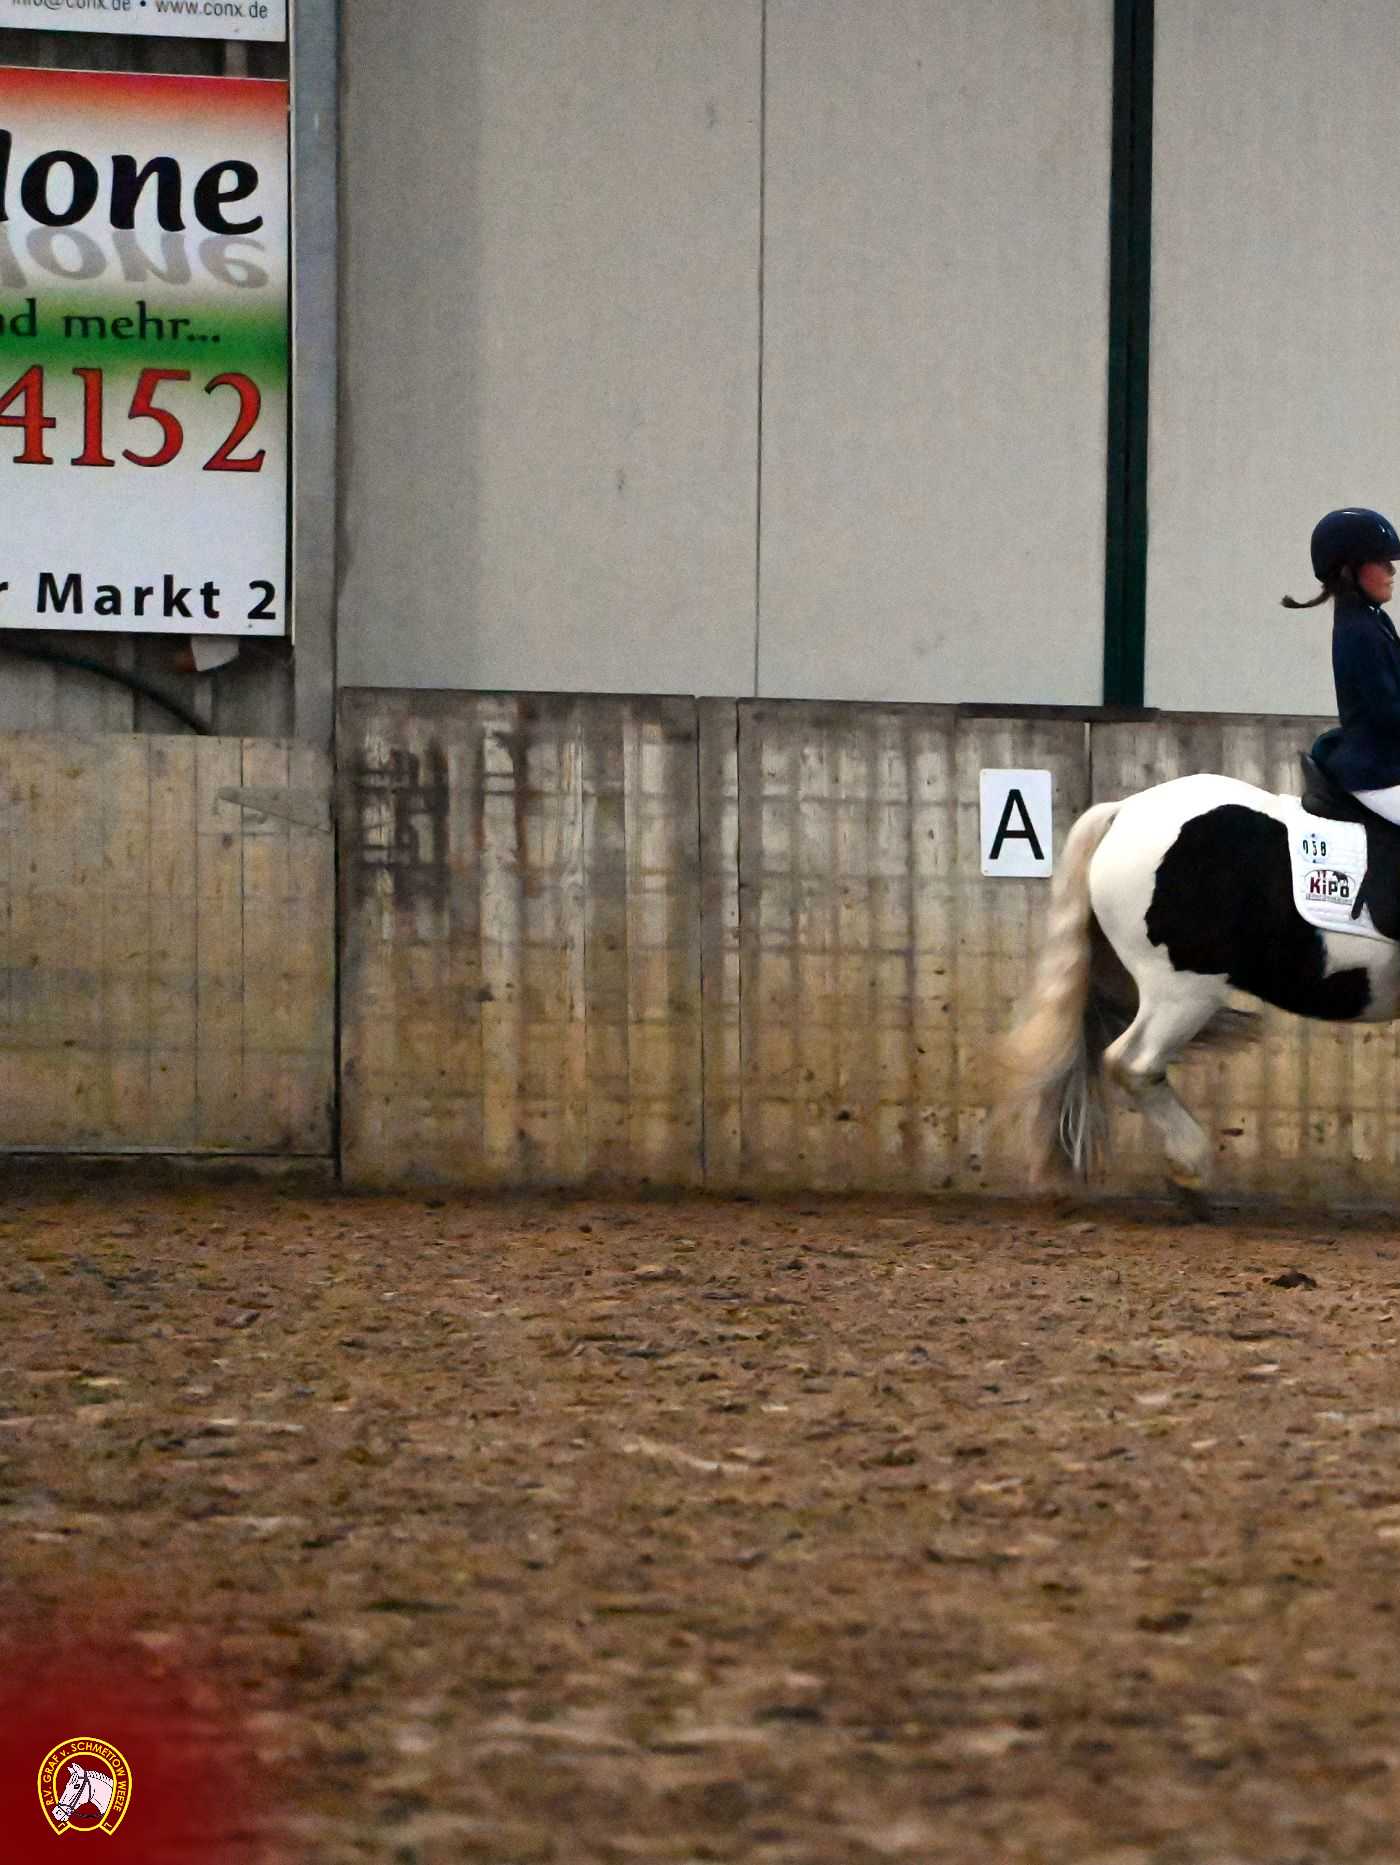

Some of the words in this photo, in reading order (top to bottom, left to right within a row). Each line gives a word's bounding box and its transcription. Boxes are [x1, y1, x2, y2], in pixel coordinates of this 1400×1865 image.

[155, 0, 268, 18] www.conx.de
[0, 297, 37, 338] d
[64, 301, 220, 343] mehr...
[0, 364, 266, 473] 4152
[36, 571, 220, 619] Markt
[247, 580, 277, 620] 2
[989, 788, 1045, 860] A
